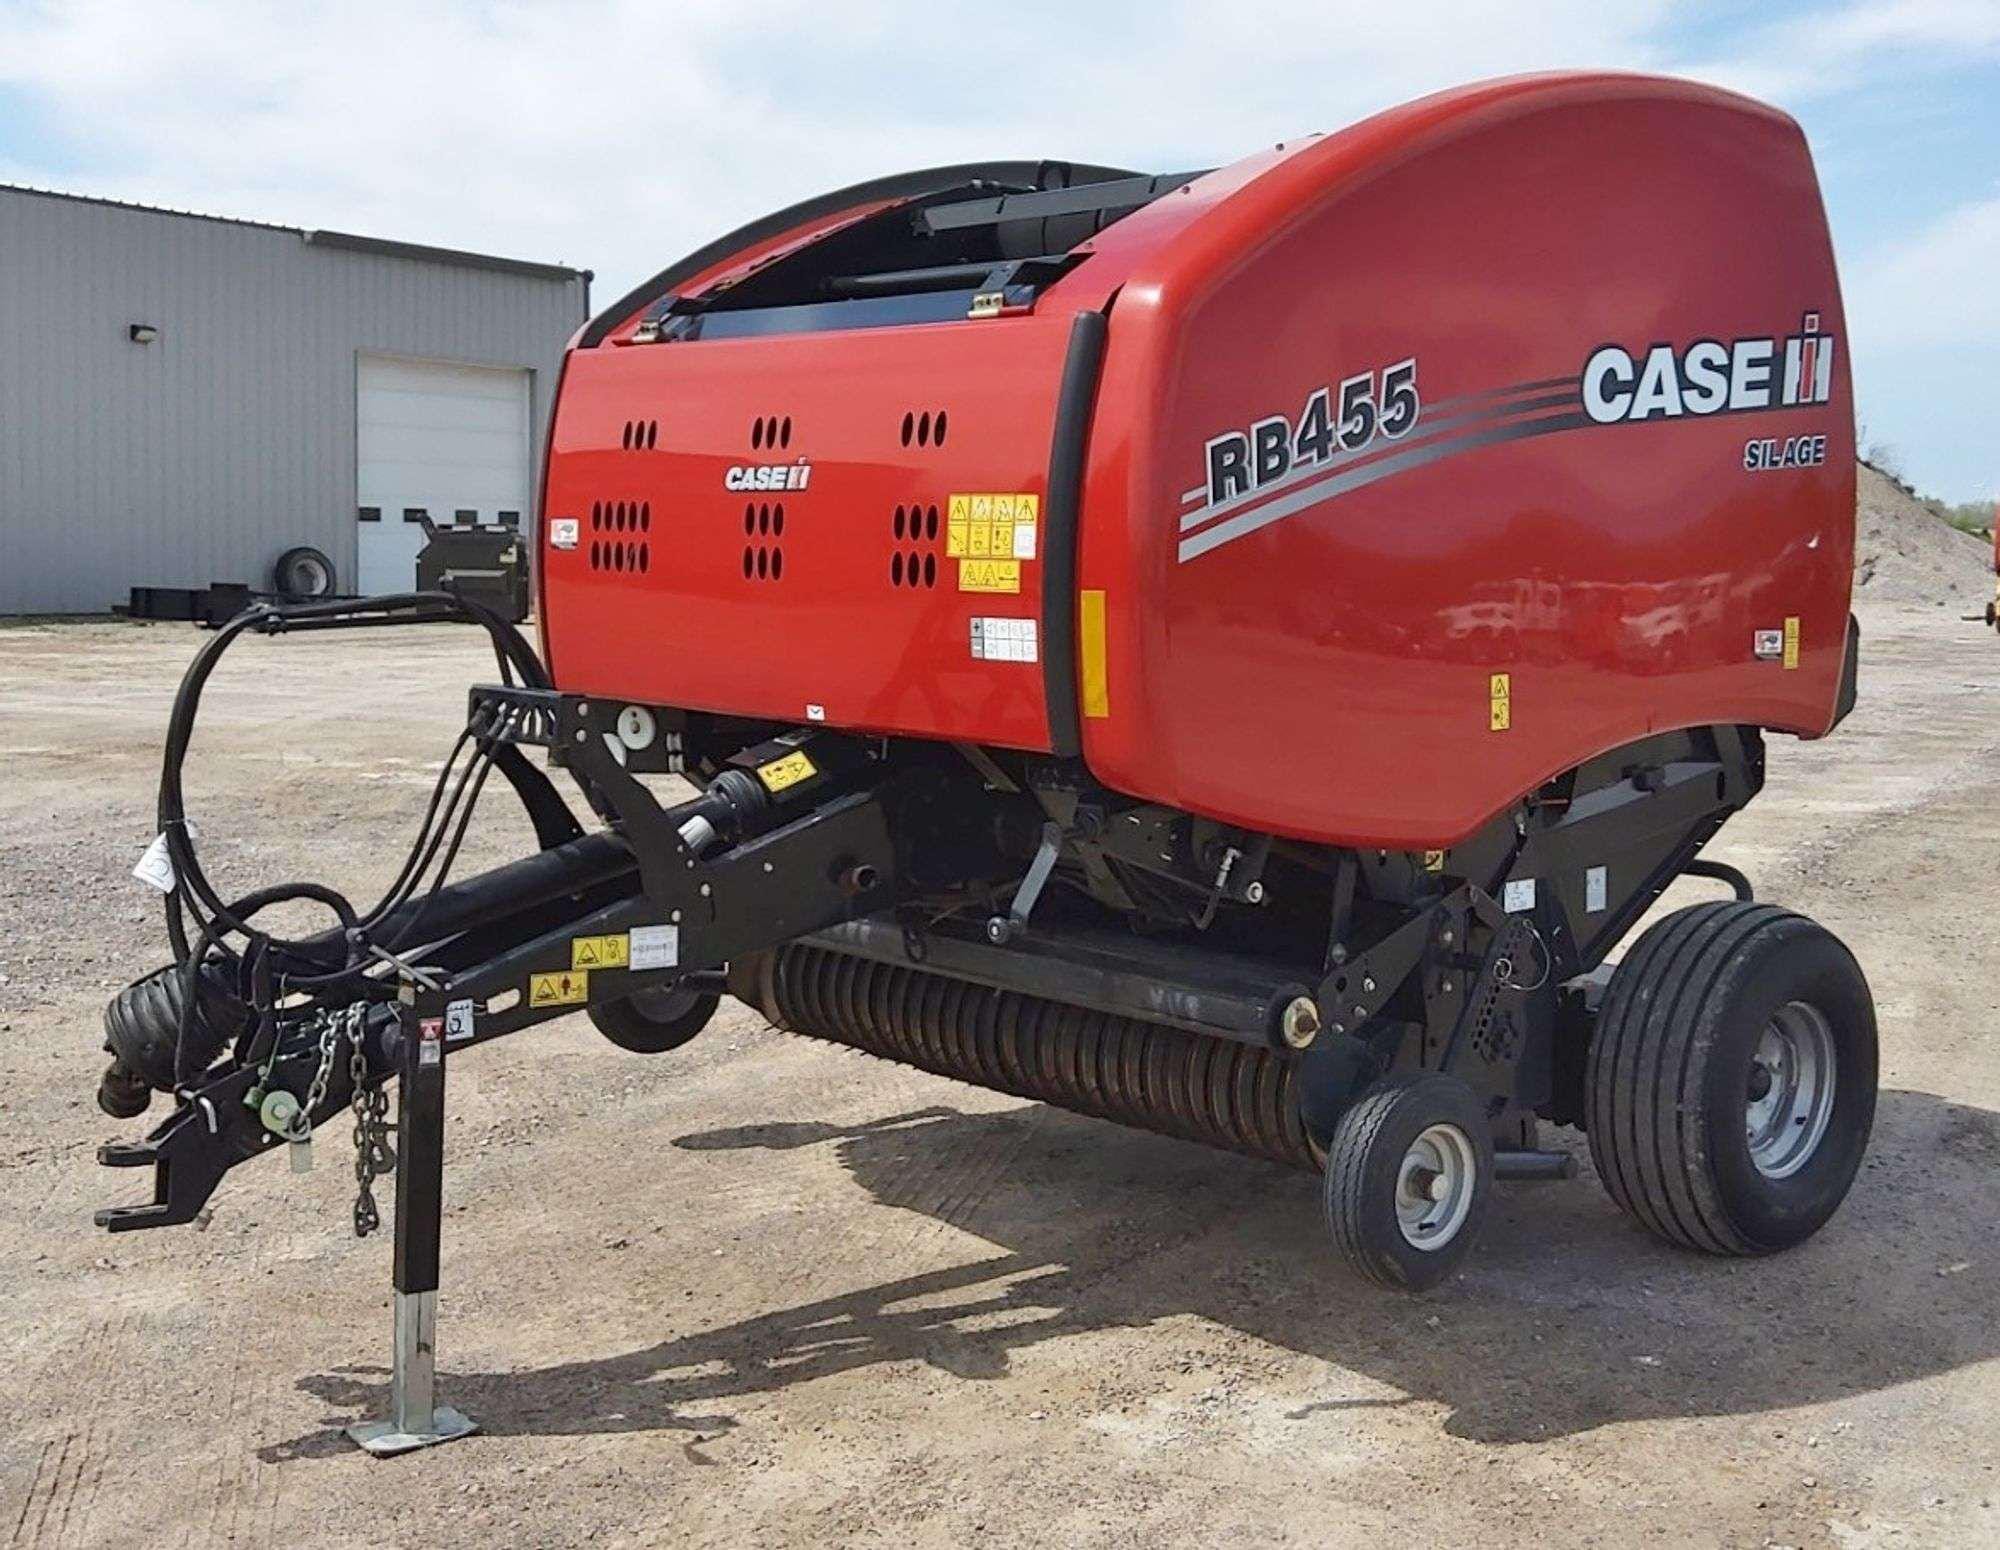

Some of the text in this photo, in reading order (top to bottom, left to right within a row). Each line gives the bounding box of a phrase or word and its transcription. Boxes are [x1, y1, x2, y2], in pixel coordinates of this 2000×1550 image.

[1583, 339, 1774, 423] CASE
[1205, 357, 1421, 509] RB455
[1743, 434, 1827, 471] SILAGE
[724, 465, 788, 491] CASE
